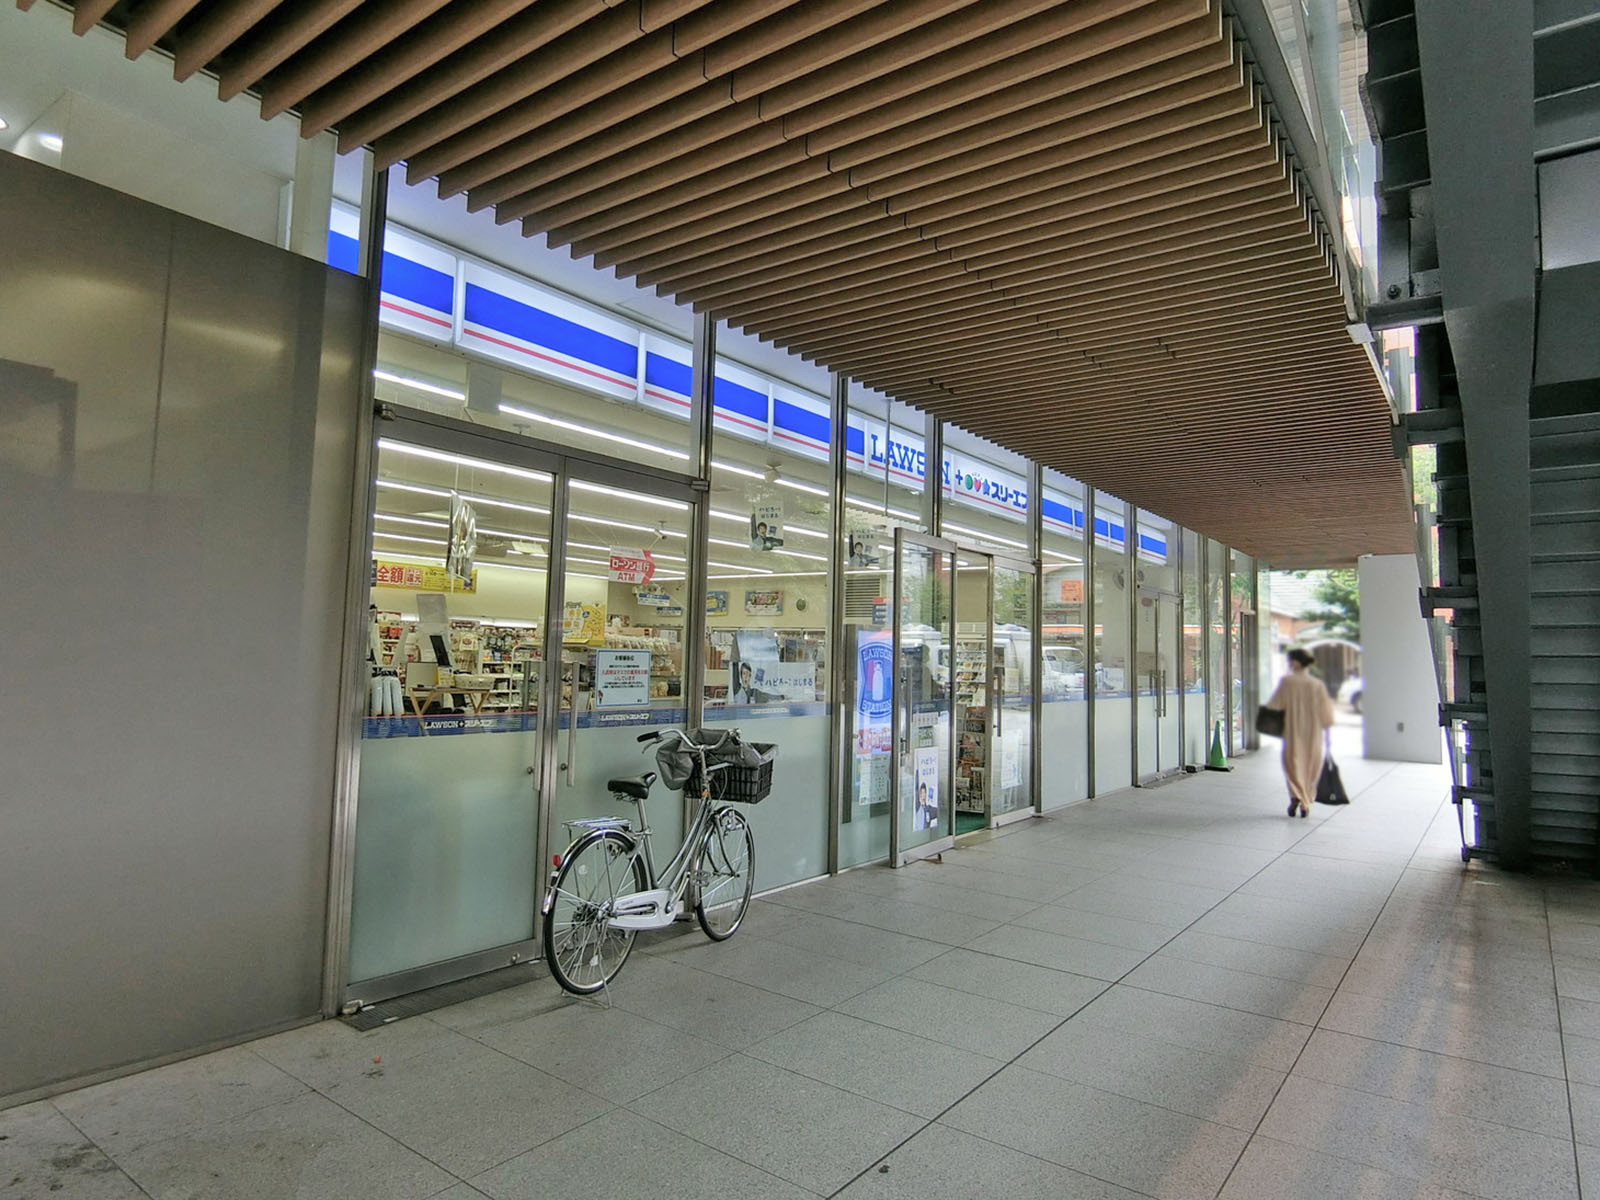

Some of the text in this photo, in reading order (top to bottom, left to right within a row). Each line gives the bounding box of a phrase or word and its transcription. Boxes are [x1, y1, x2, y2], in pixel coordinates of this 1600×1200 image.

[871, 434, 950, 485] LAWSN
[377, 565, 404, 583] 全額
[618, 573, 635, 581] ATM
